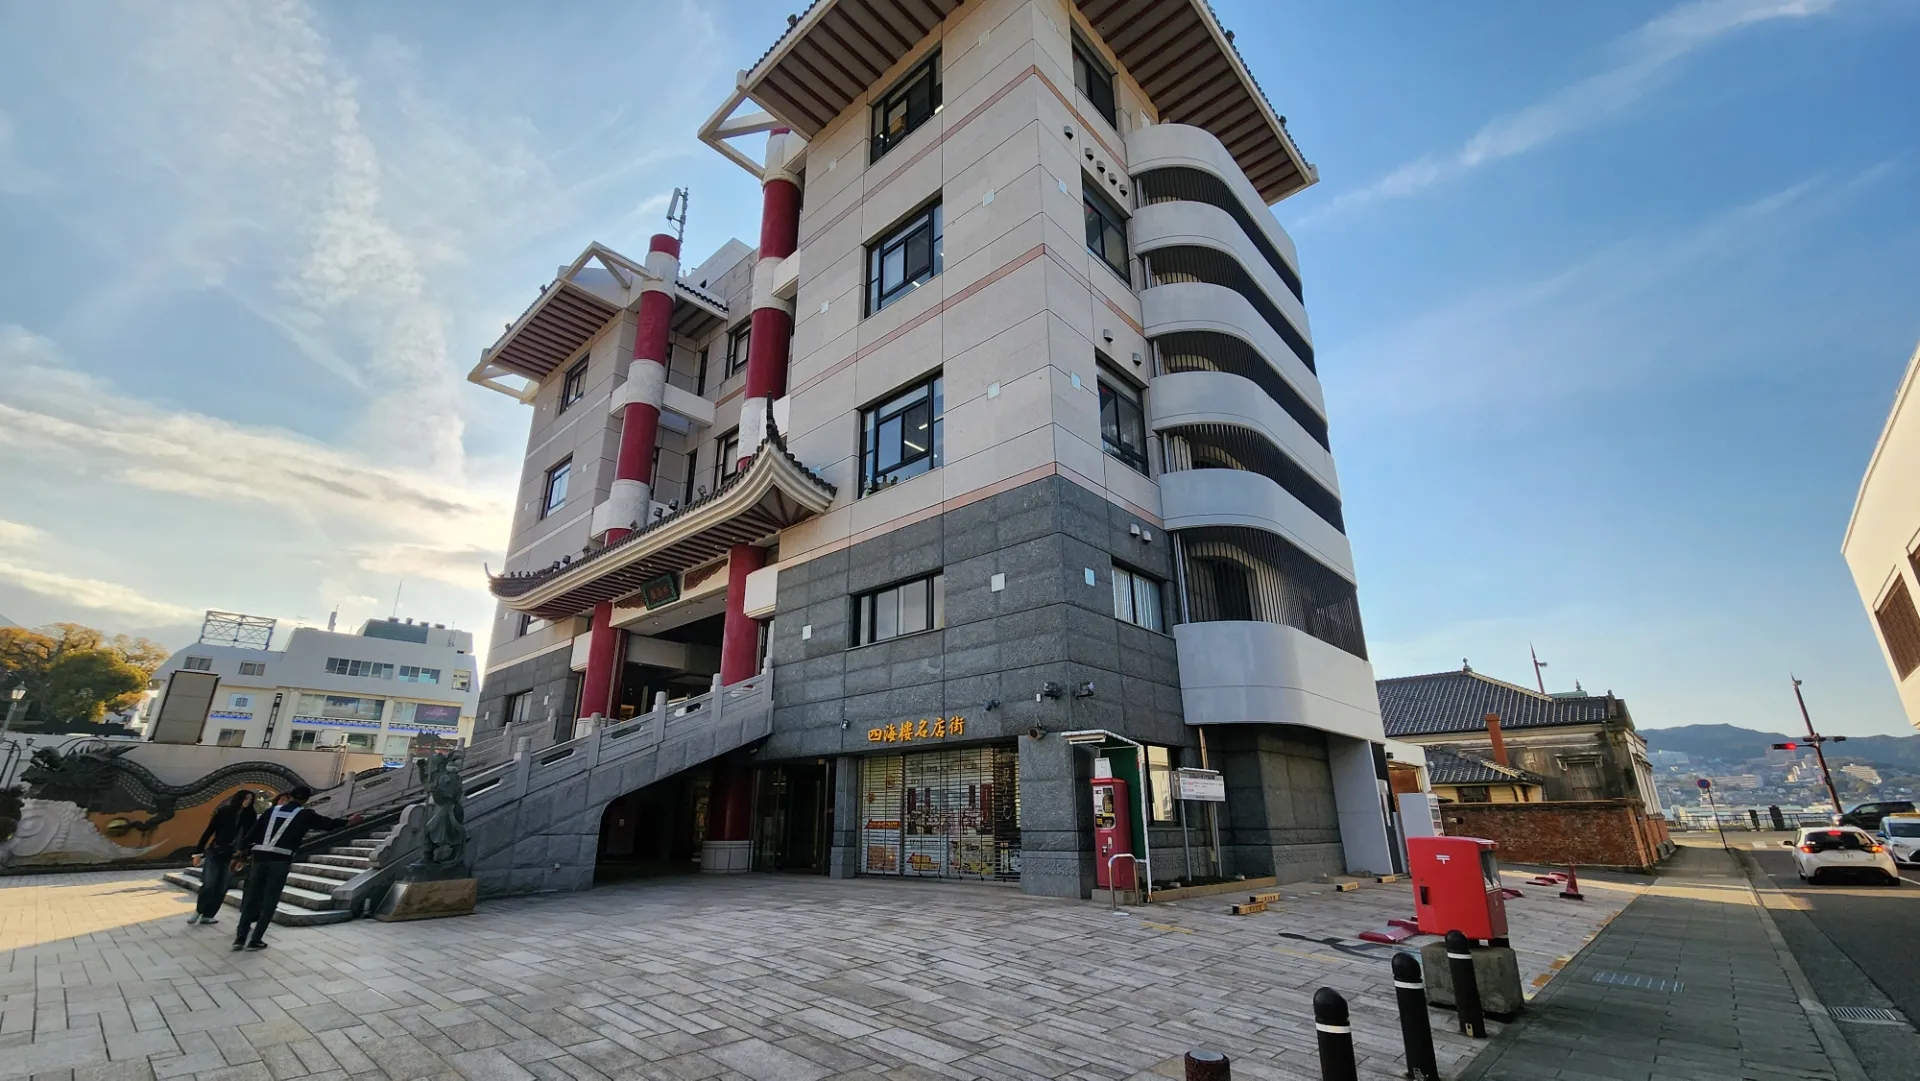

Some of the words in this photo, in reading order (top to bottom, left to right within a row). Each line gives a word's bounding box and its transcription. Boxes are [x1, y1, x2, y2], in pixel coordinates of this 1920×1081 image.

[867, 715, 965, 743] 四海樓名店街
